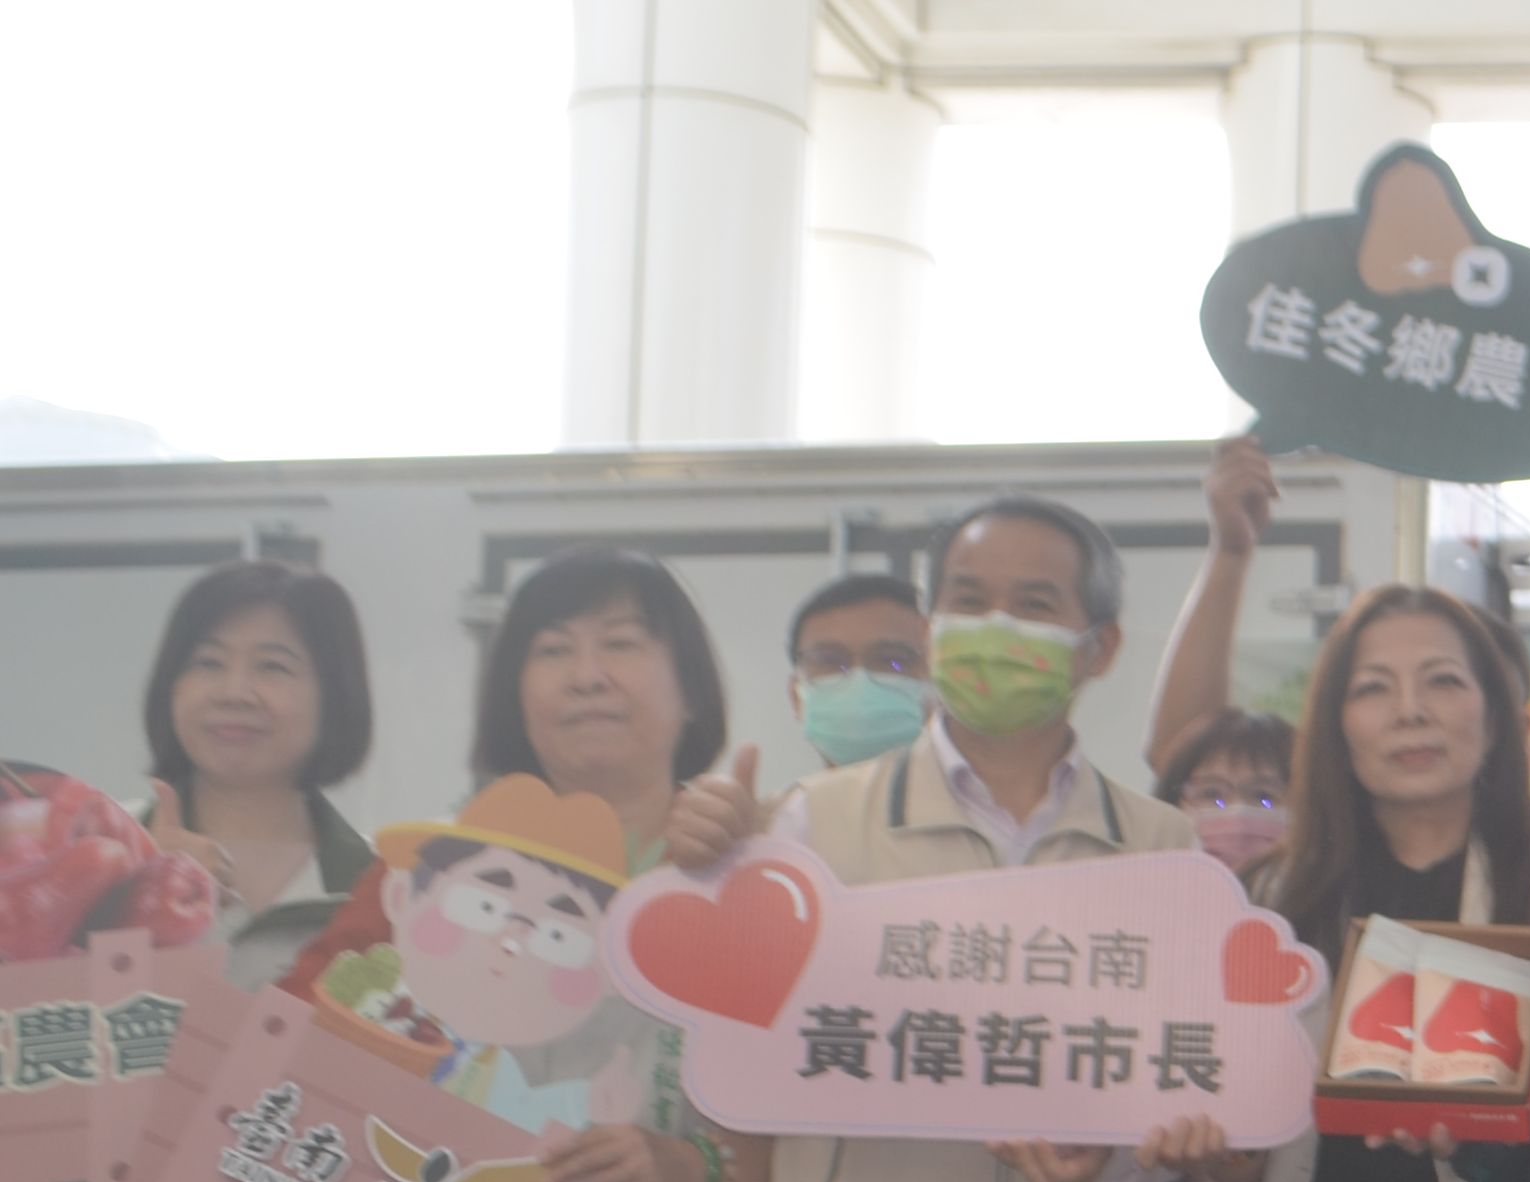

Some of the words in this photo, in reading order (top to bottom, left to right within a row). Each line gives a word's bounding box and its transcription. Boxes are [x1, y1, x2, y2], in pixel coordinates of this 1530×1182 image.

[875, 920, 1150, 991] 感謝台南
[0, 993, 184, 1090] 農會
[797, 1003, 1225, 1094] 黃偉哲市長
